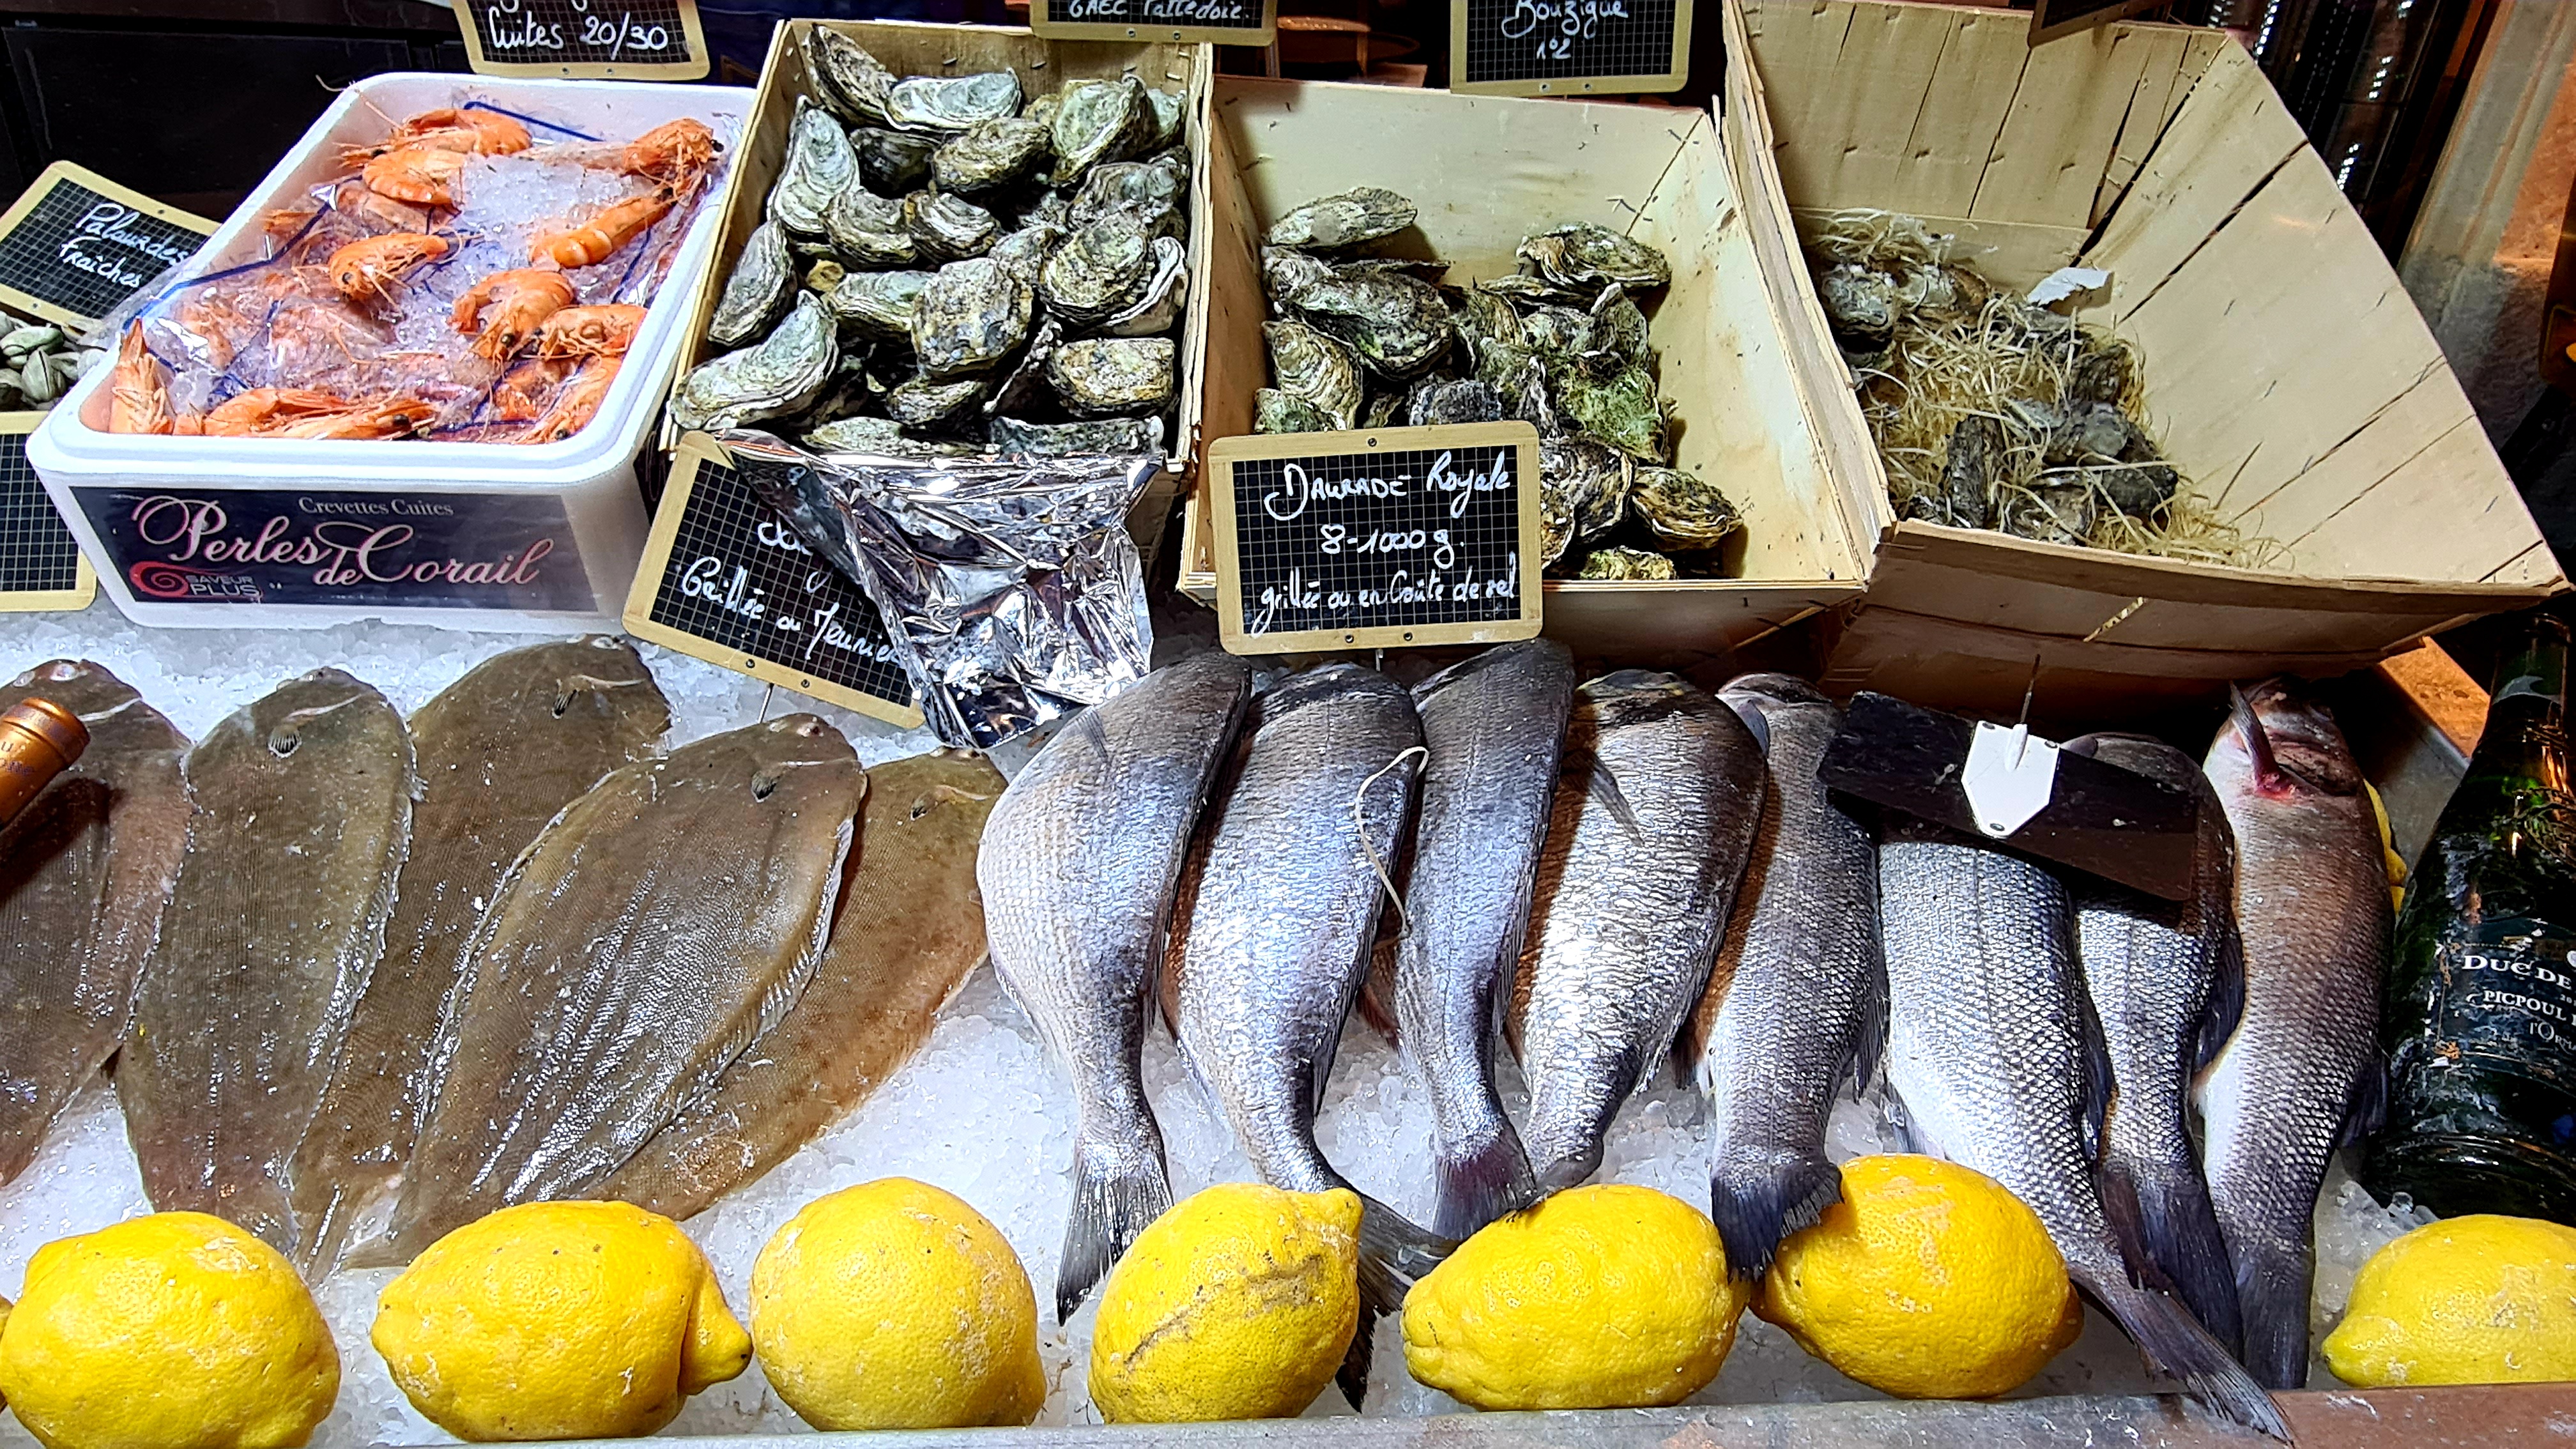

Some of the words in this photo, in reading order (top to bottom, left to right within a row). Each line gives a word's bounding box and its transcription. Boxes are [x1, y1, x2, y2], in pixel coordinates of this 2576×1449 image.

[489, 6, 565, 49] Cuites
[579, 12, 669, 61] 20/30
[1426, 450, 1511, 519] Royale
[298, 496, 390, 514] Crevettes
[390, 498, 454, 516] Cuites
[132, 495, 335, 562] Perles
[1320, 523, 1427, 555] 8-1000
[312, 548, 364, 585] de
[314, 521, 555, 583] Corail
[190, 583, 261, 596] PLUS
[1328, 589, 1351, 610] ou
[1358, 588, 1387, 608] en
[1452, 565, 1480, 602] de
[1485, 551, 1516, 599] sel
[776, 615, 801, 631] ou
[2462, 954, 2534, 977] DUC
[2534, 967, 2572, 990] DE
[2482, 990, 2567, 1022] PICPOUL
